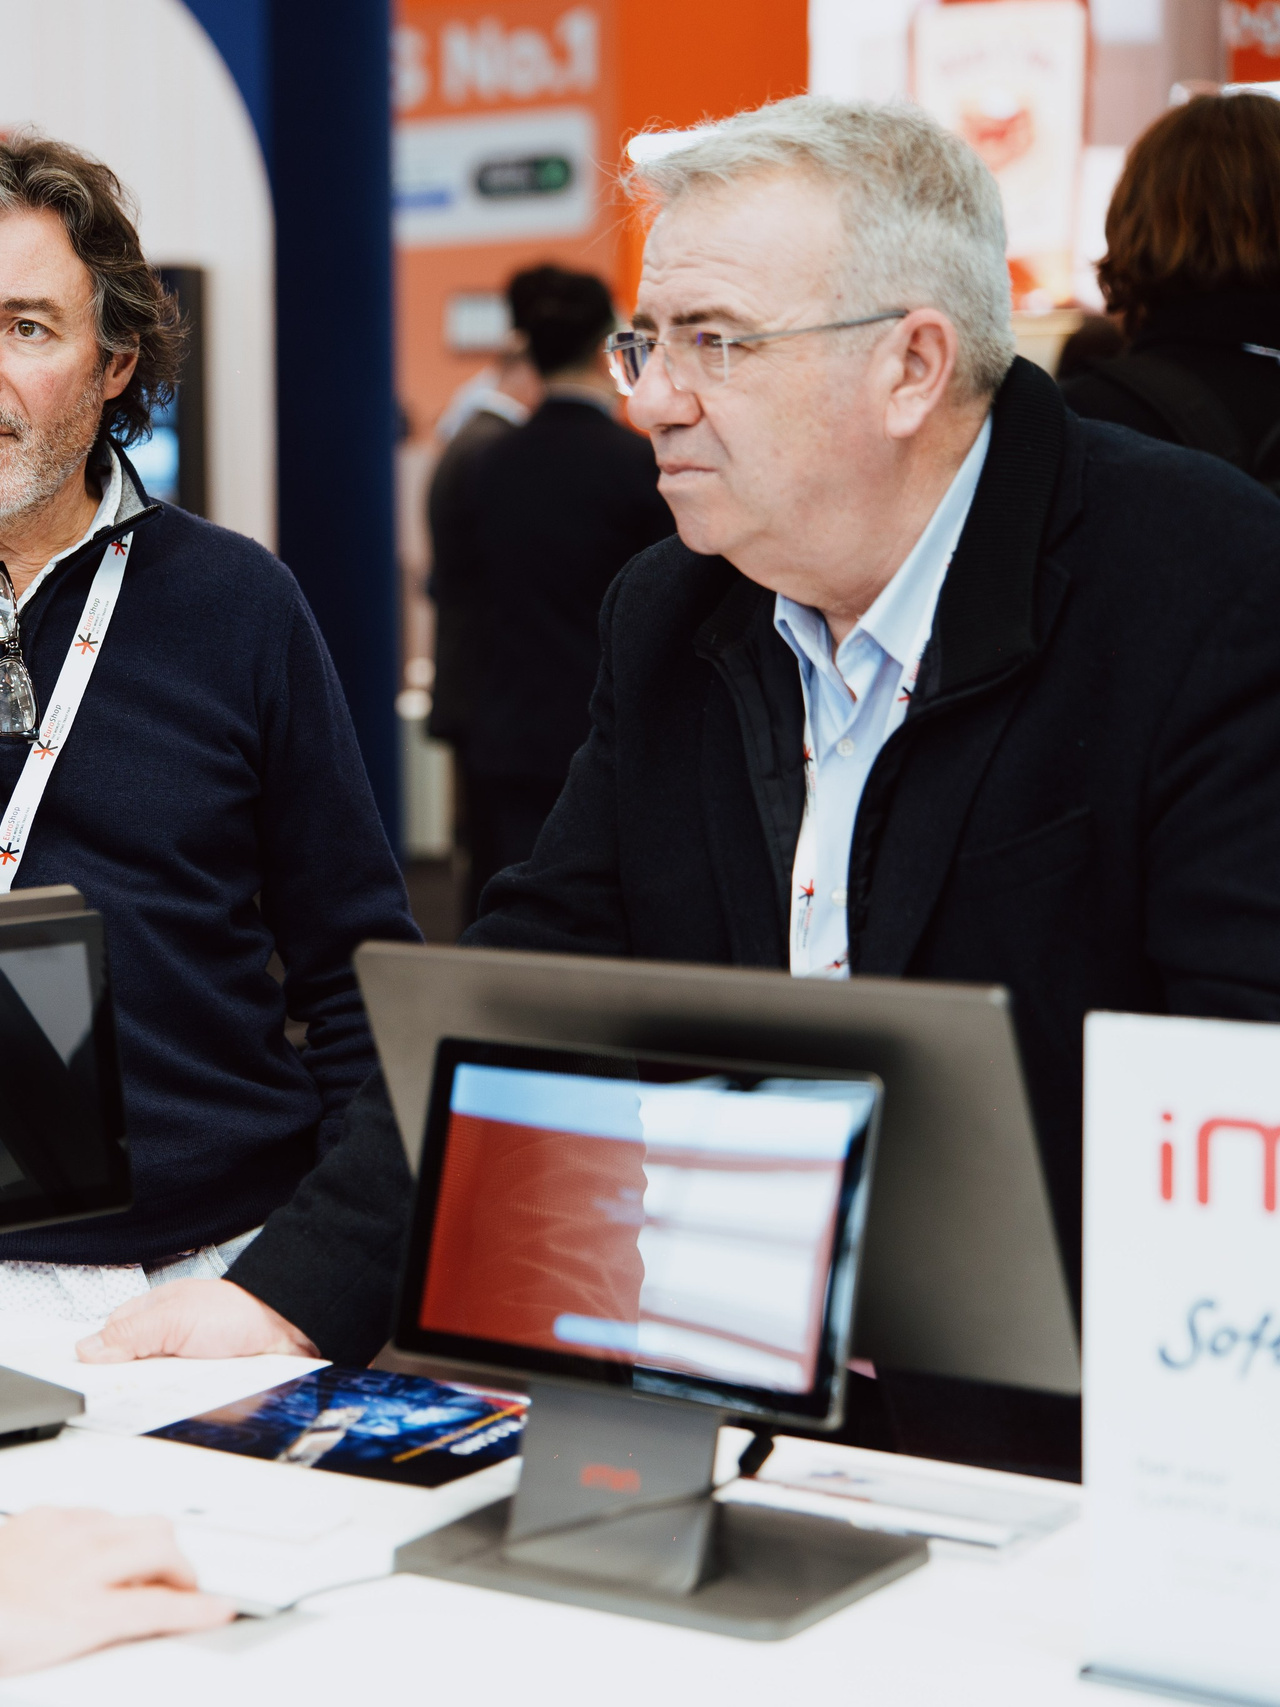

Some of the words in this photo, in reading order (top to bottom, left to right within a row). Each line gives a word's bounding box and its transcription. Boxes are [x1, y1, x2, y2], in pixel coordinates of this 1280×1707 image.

[83, 597, 101, 631] EuroShop
[43, 704, 62, 738] EuroShop
[3, 806, 21, 841] EuroShop
